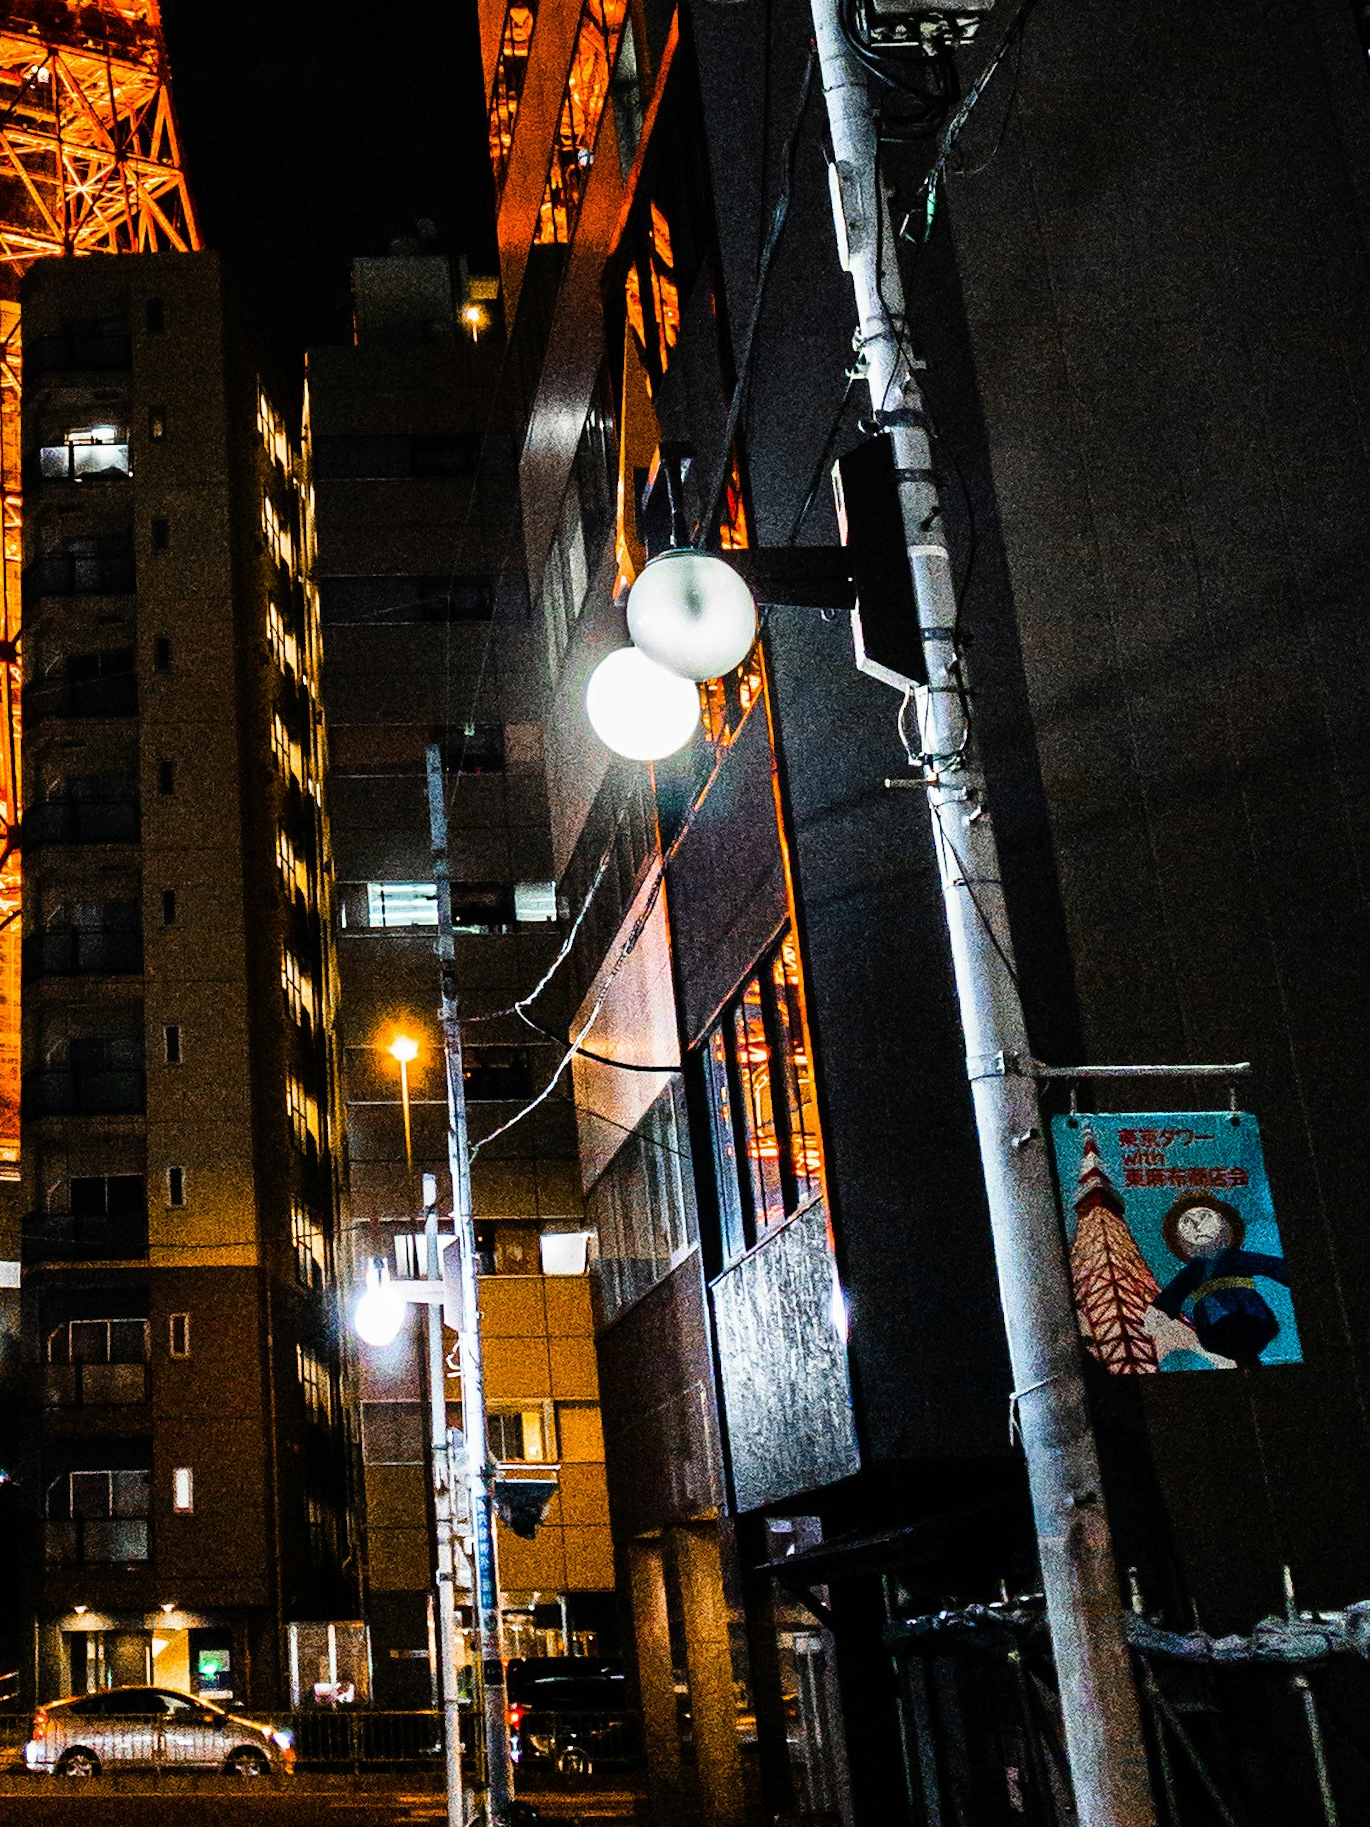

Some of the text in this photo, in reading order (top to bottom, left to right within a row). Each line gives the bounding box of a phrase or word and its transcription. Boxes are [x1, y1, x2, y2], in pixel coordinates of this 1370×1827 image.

[1119, 1129, 1214, 1147] 東京タワー
[1122, 1151, 1165, 1166] with
[1124, 1166, 1249, 1187] 東麻布商店会
